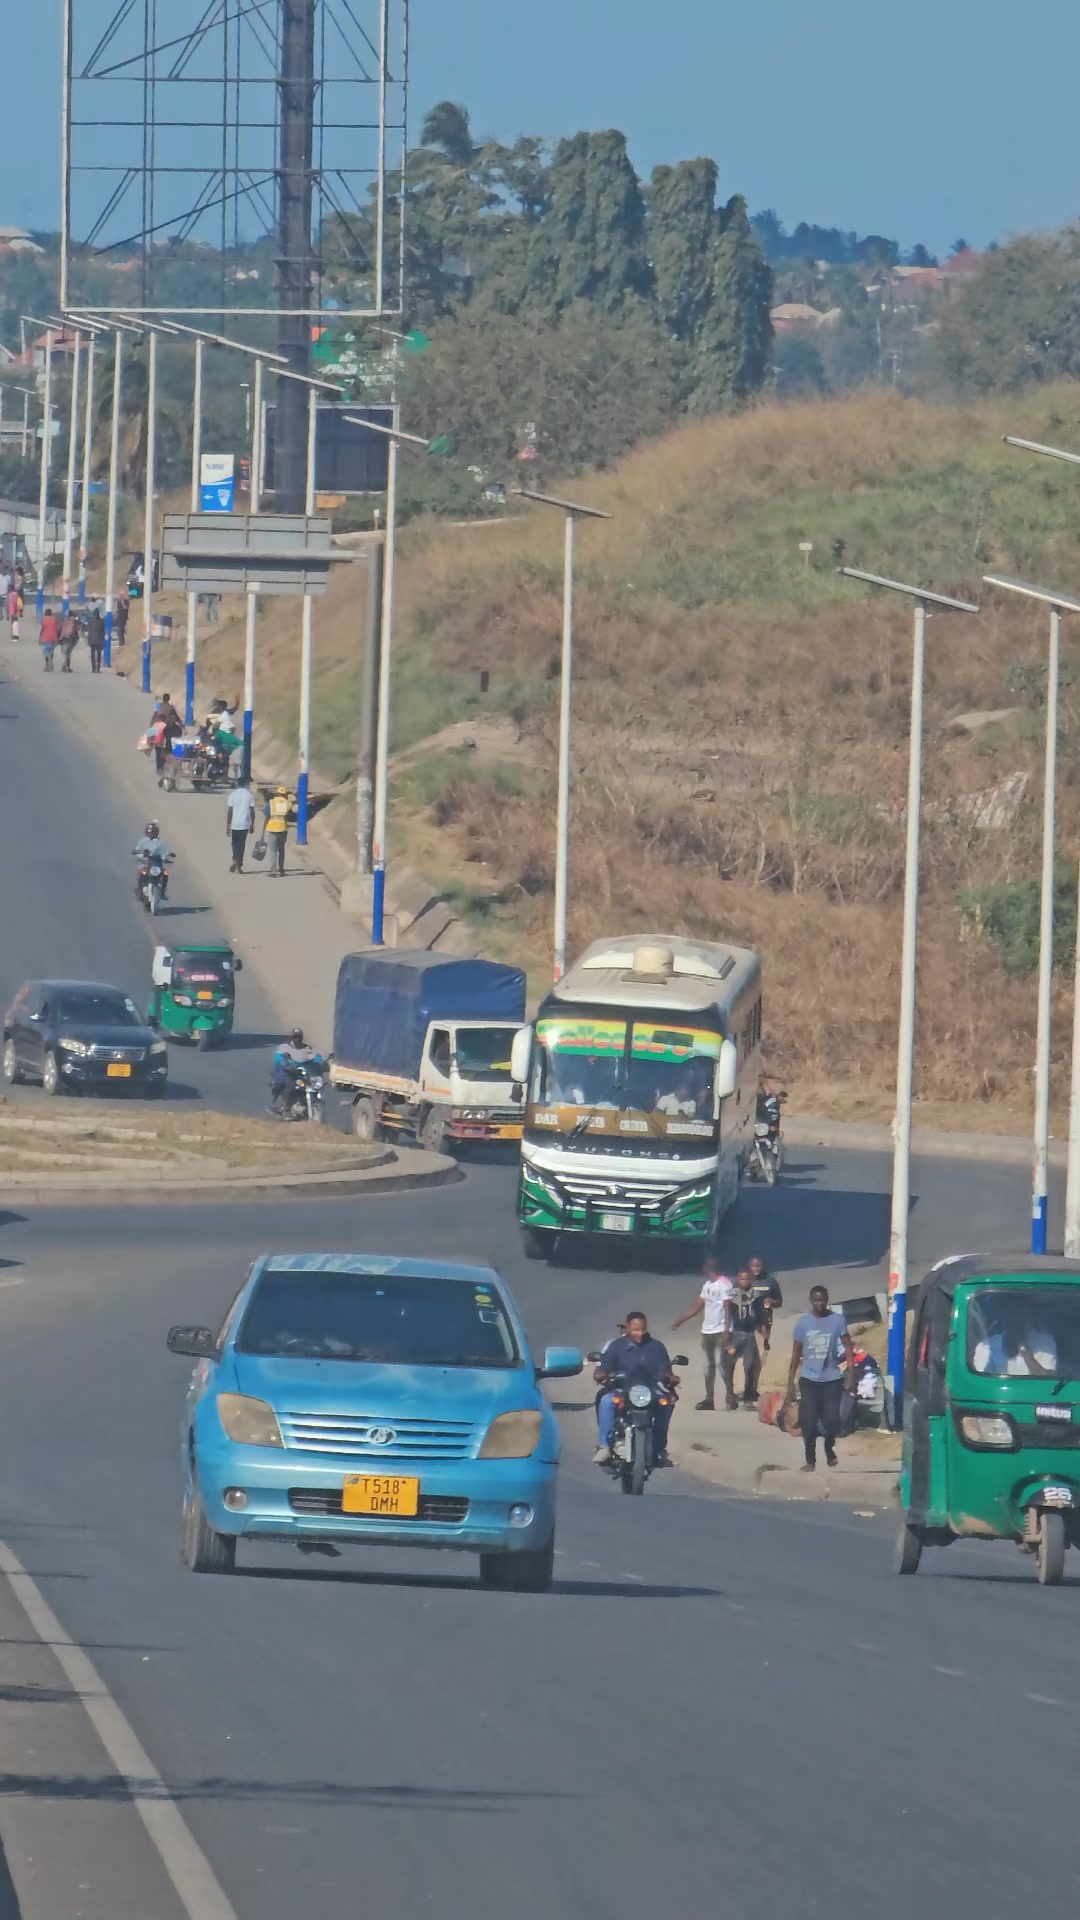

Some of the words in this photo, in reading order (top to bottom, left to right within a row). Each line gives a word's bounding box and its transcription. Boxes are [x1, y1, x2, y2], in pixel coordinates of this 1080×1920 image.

[534, 1113, 559, 1125] DAR
[362, 1478, 400, 1495] T518
[371, 1496, 399, 1513] DMH
